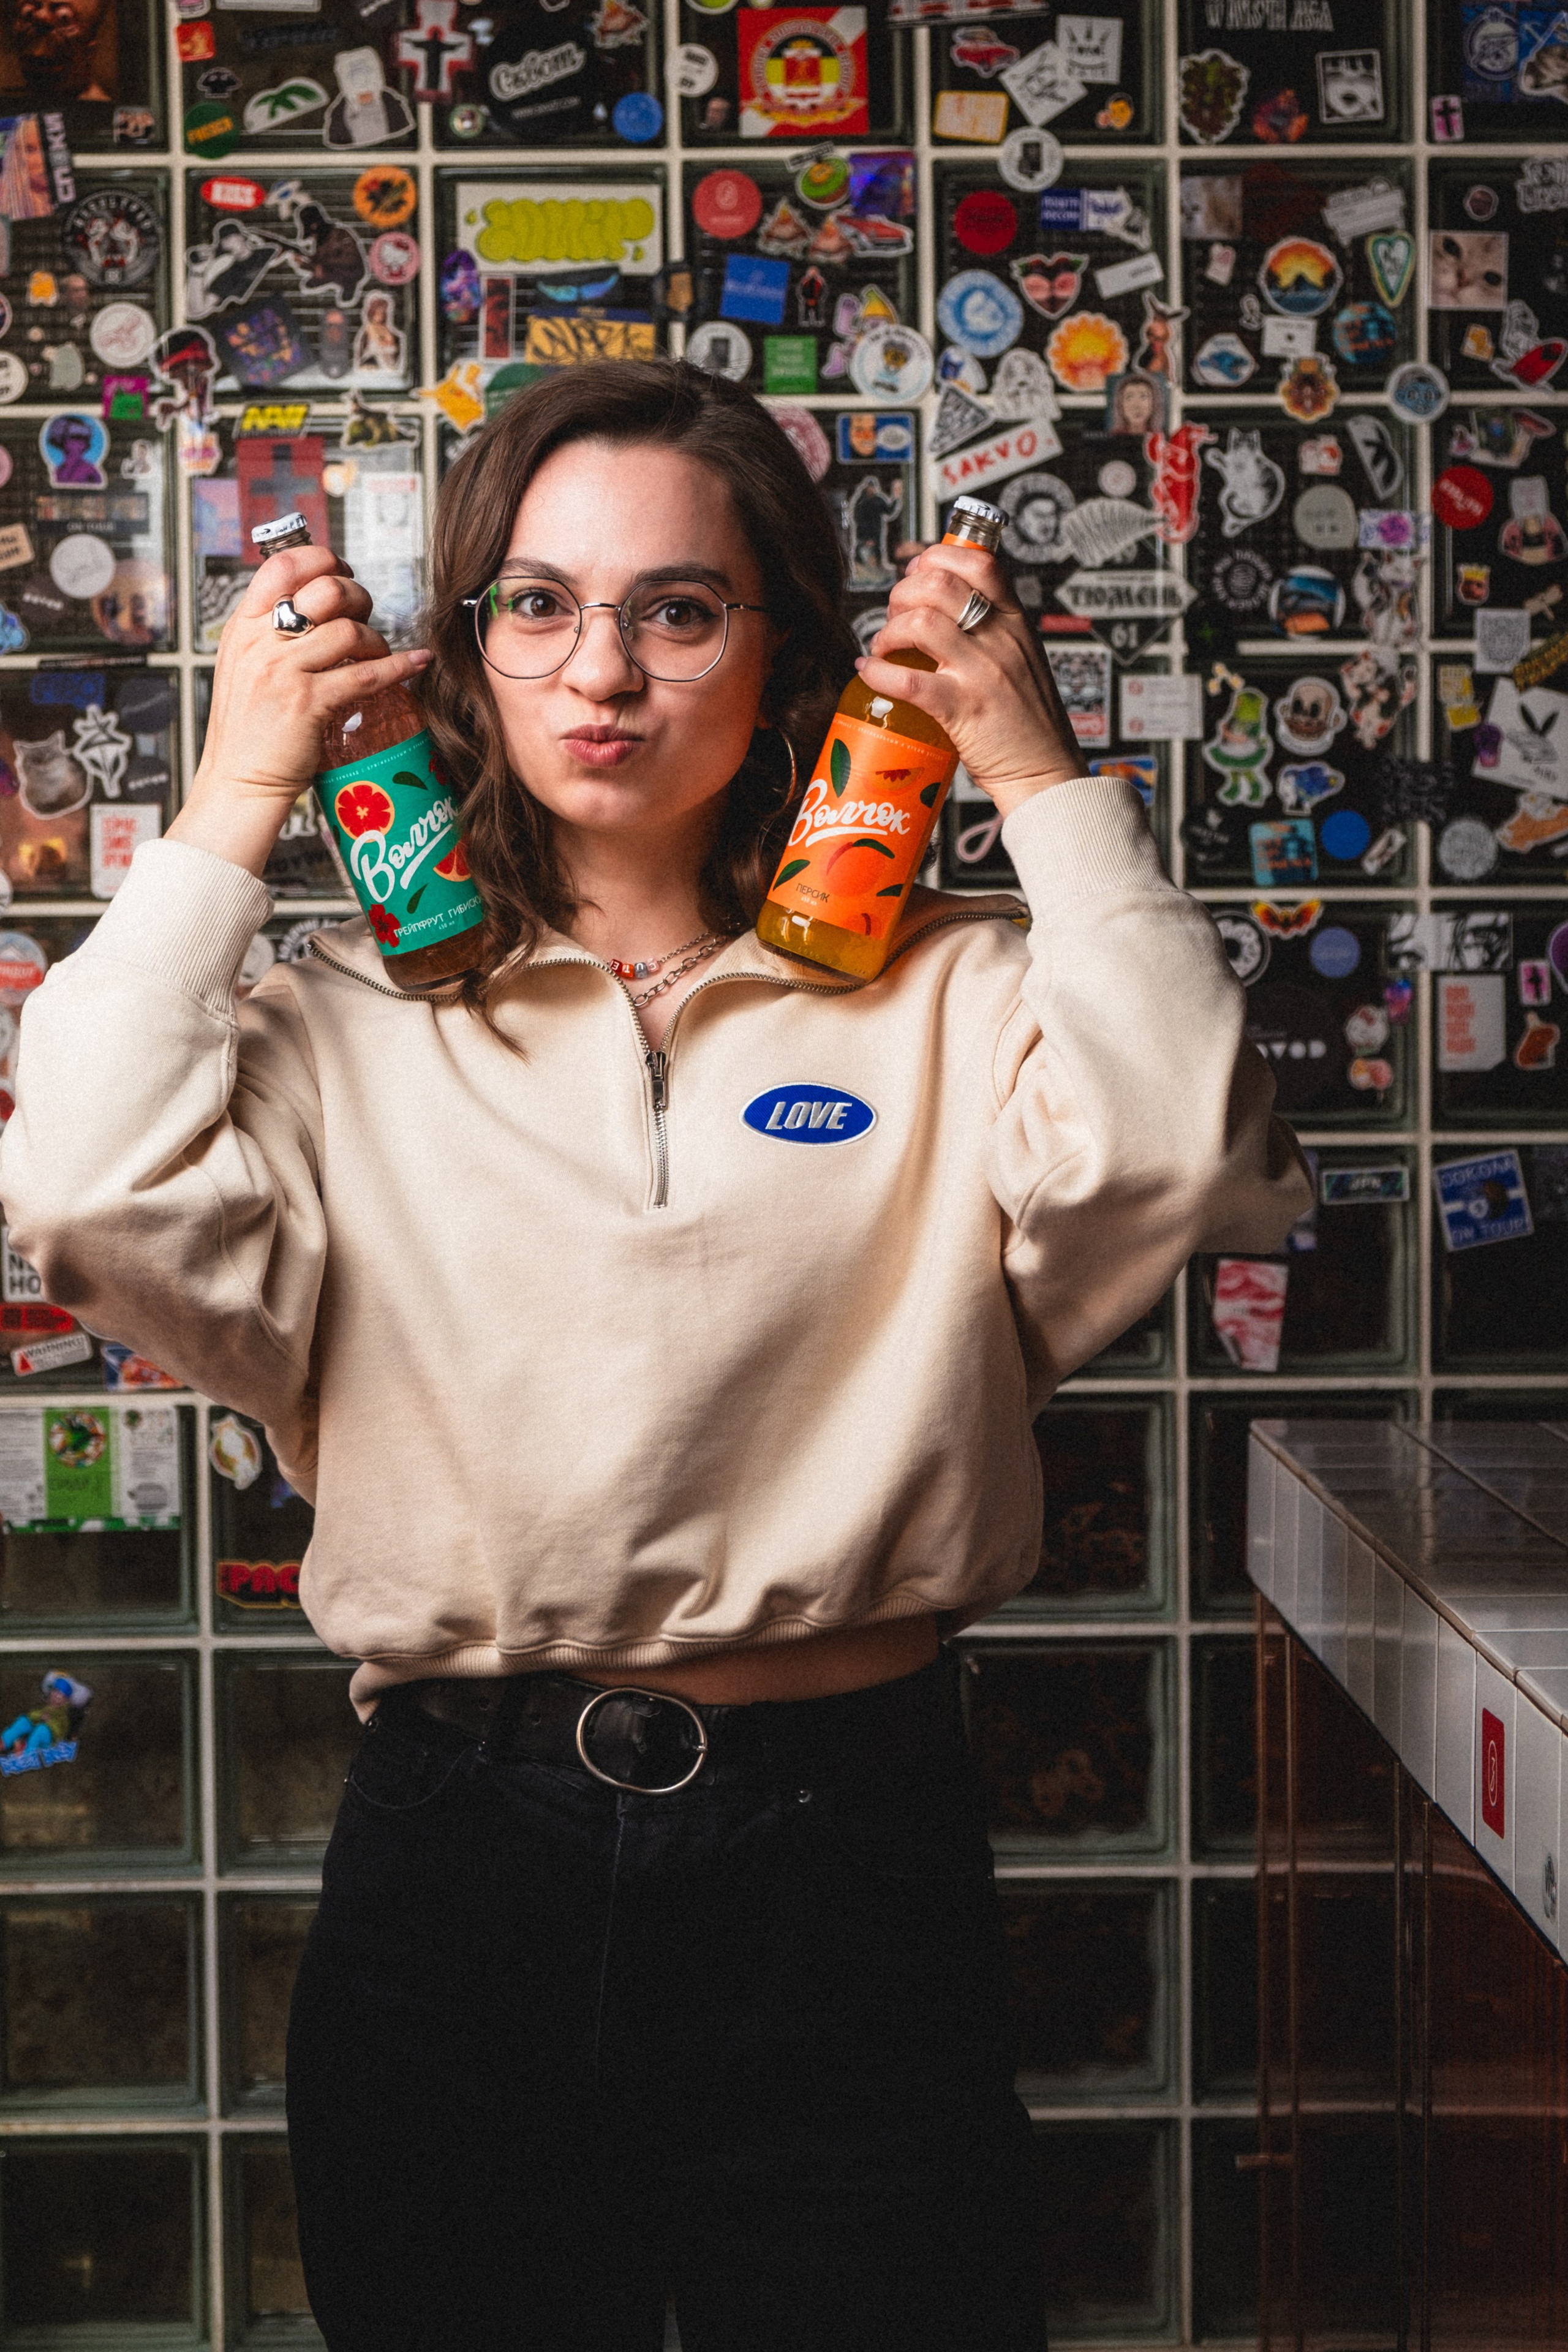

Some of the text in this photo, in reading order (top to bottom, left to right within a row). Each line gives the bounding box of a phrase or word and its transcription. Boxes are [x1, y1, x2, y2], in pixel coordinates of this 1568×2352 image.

[796, 883, 831, 904] ПЕРСИК
[393, 913, 443, 938] ГРЕЙПФРУТ
[765, 1101, 853, 1129] LOVE
